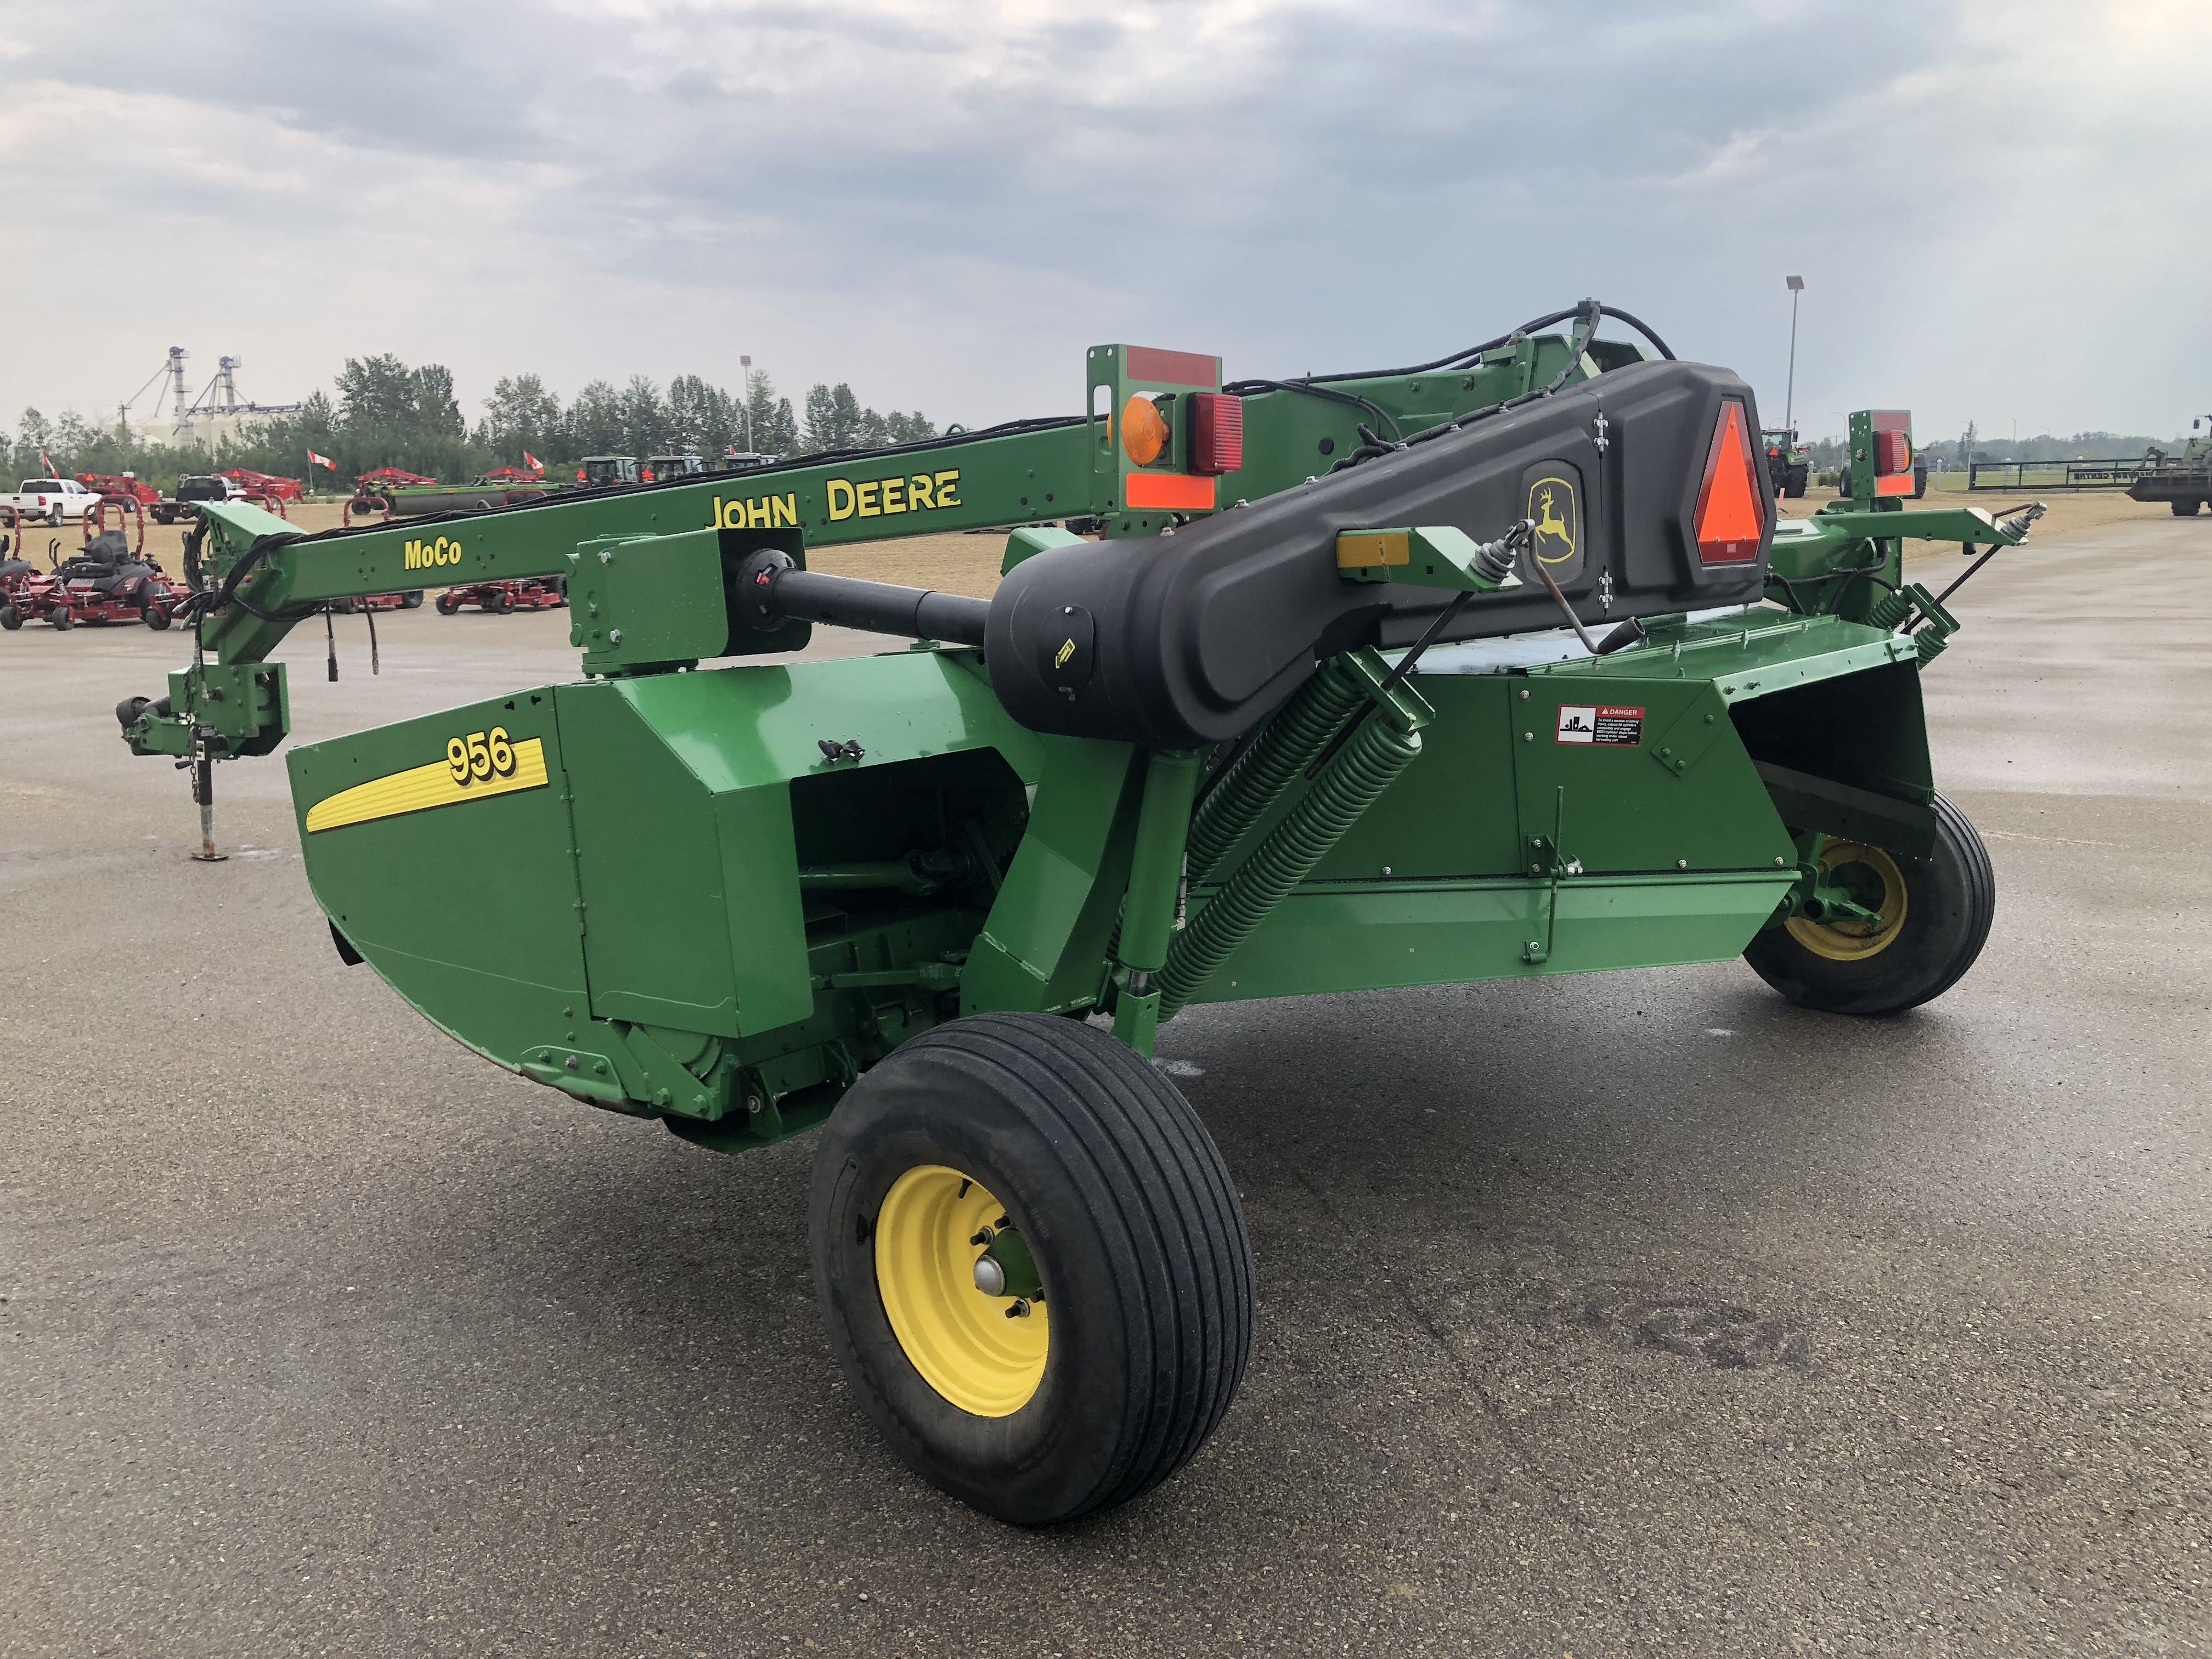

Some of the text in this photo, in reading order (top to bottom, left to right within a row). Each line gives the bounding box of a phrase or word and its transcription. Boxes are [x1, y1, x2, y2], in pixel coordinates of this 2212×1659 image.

[705, 469, 962, 528] JOHN DEERE
[404, 535, 462, 571] MoCo
[447, 725, 516, 786] 956
